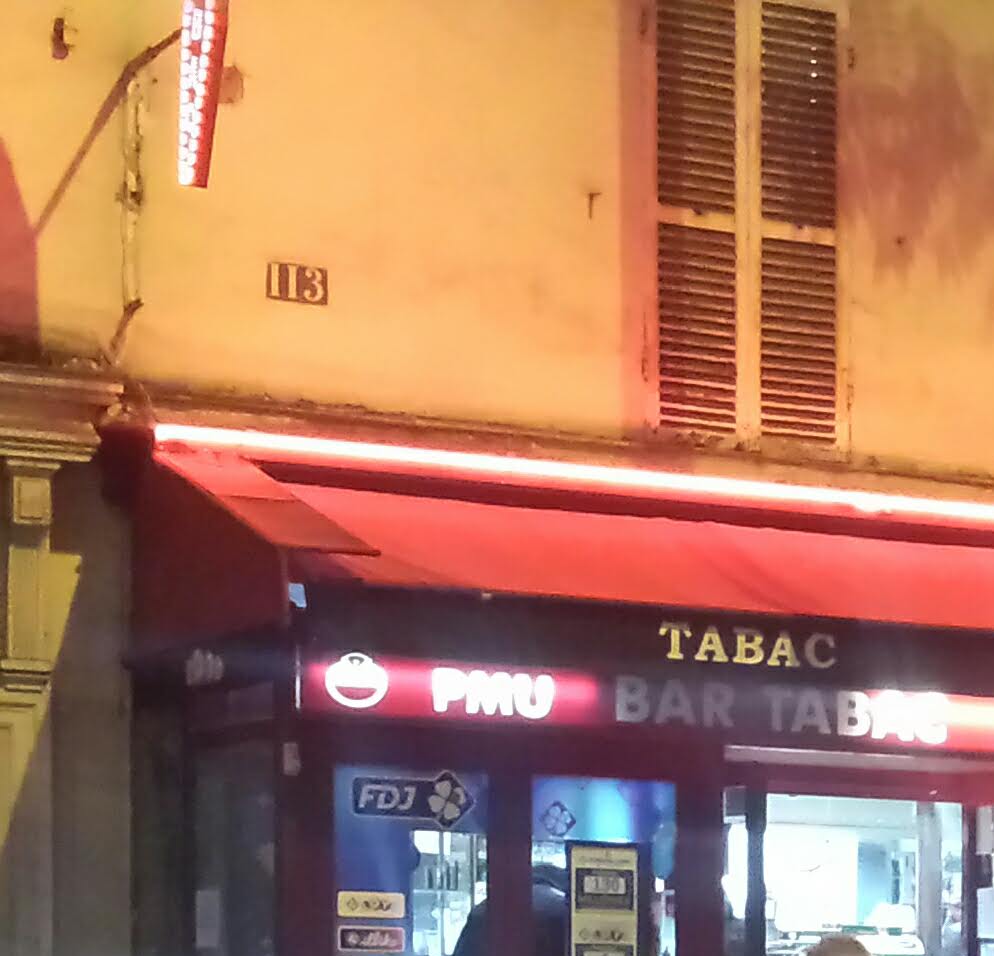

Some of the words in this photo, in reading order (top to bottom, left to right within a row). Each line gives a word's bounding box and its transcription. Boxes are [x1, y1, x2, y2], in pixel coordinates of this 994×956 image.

[269, 264, 326, 303] 113
[658, 622, 837, 669] TABAC
[431, 667, 556, 720] PMU
[615, 676, 735, 728] BAR
[358, 785, 418, 811] FDJ
